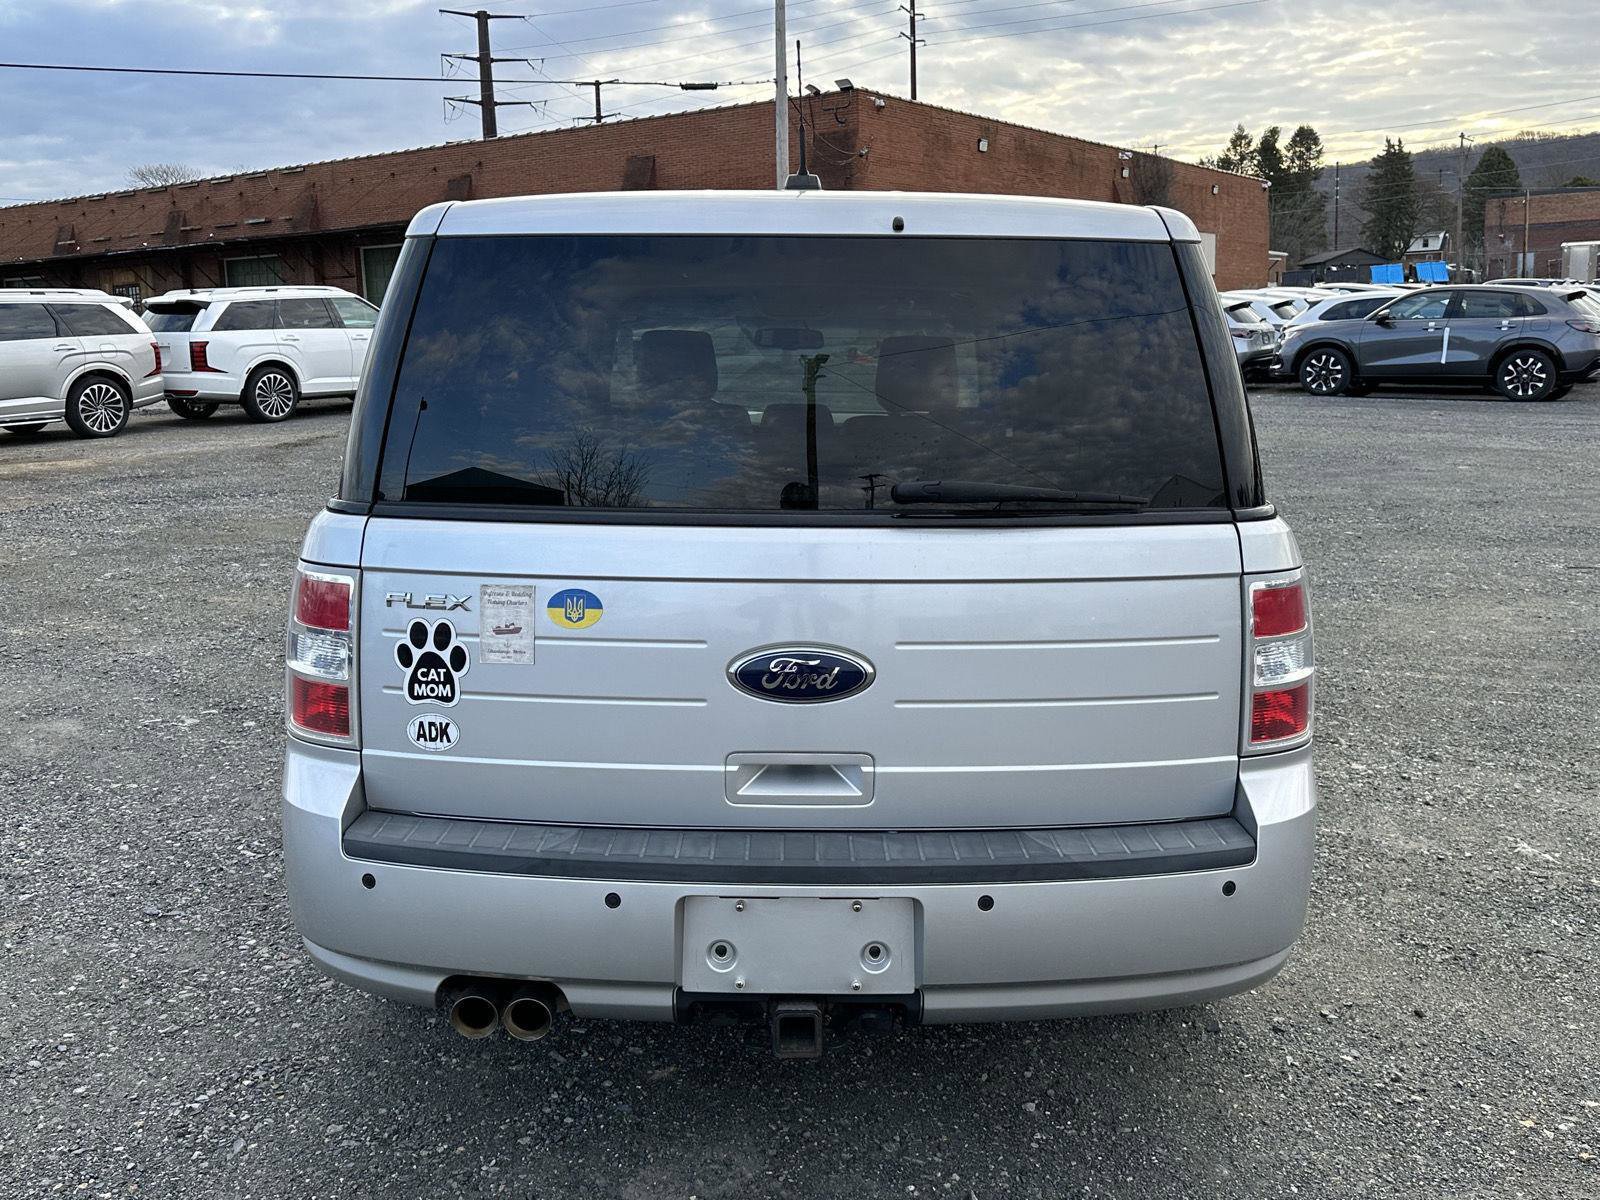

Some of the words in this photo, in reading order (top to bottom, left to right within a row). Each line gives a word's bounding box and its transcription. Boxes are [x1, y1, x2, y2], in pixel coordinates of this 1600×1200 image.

[385, 592, 473, 611] FLEX
[417, 668, 447, 682] CAT
[761, 657, 841, 690] Ford
[413, 683, 452, 698] MOM
[416, 720, 452, 743] ADK
